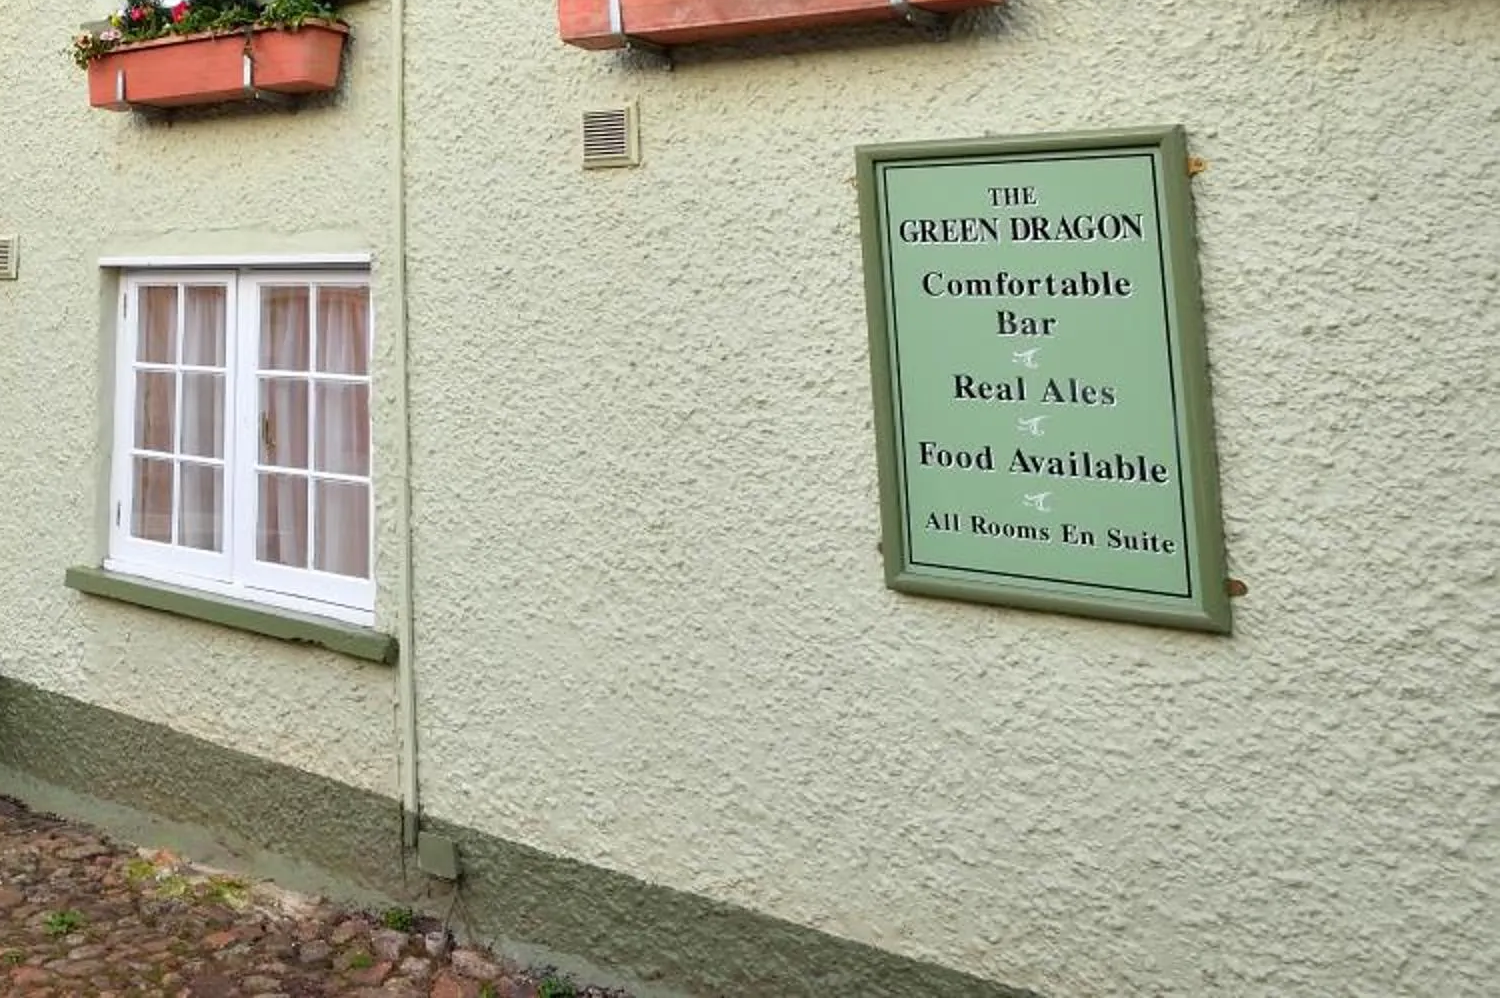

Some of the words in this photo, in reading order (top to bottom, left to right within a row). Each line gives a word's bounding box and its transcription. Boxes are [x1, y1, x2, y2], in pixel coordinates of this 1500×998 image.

[988, 186, 1038, 206] THE
[899, 217, 999, 244] GREEN
[1010, 213, 1145, 242] DRAGON
[921, 270, 1132, 298] Comfortable
[996, 310, 1057, 337] Bar
[953, 374, 1026, 402] Real
[1041, 378, 1116, 406] Ales
[919, 441, 995, 472] Food
[1009, 448, 1169, 485] Available
[924, 512, 961, 531] All
[971, 515, 1050, 542] Rooms
[1062, 525, 1096, 547] En
[1107, 528, 1178, 555] Suite
